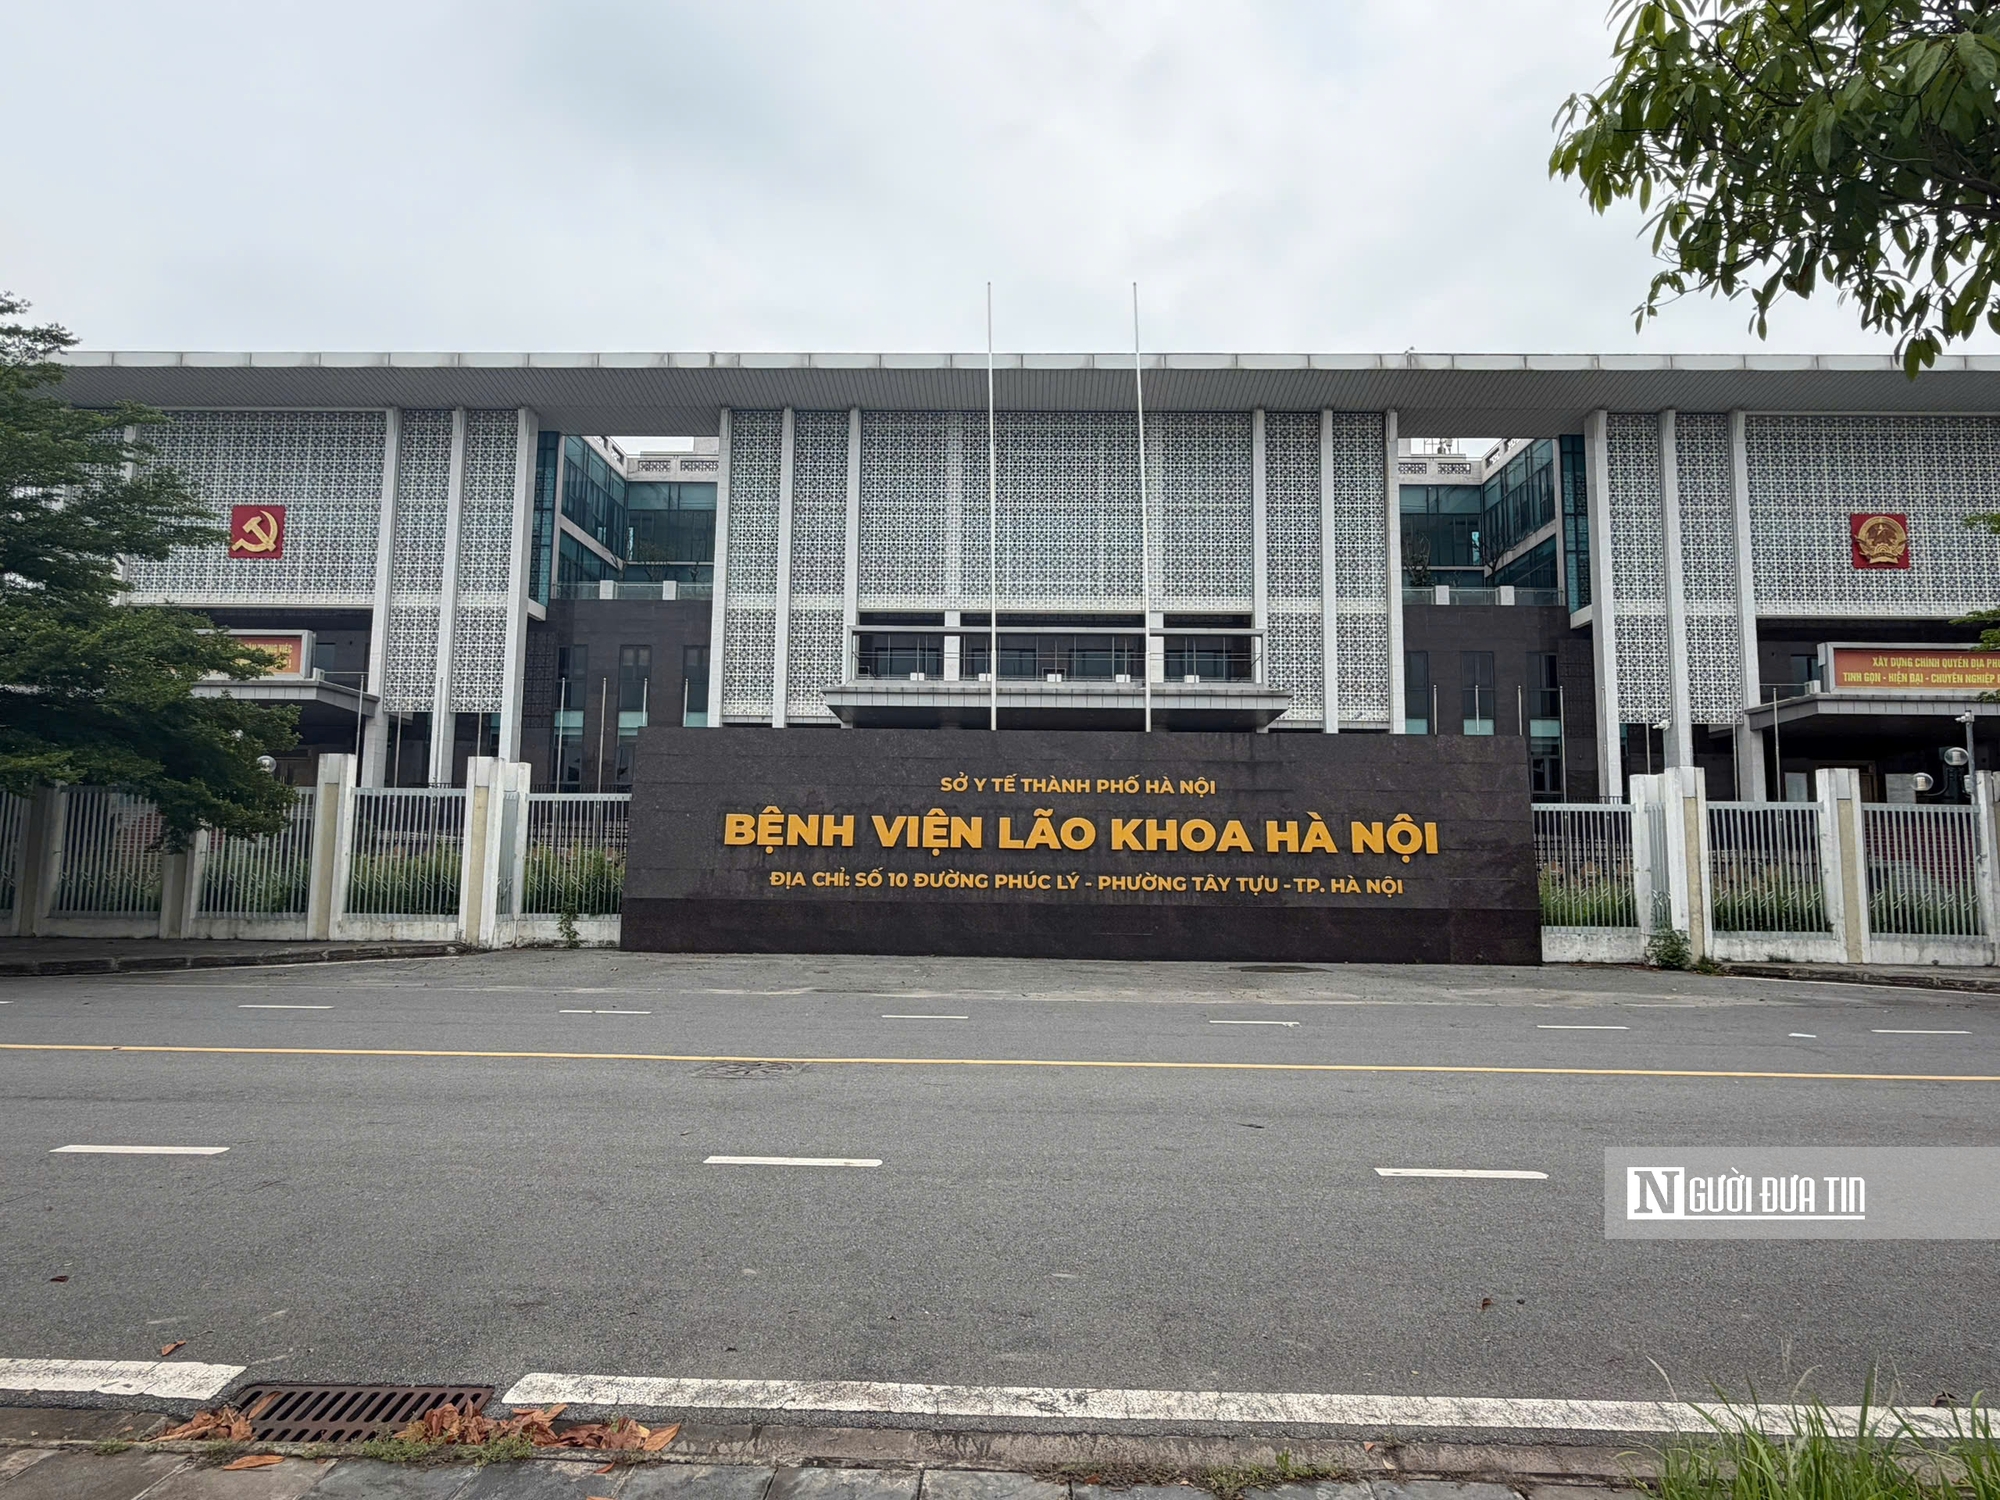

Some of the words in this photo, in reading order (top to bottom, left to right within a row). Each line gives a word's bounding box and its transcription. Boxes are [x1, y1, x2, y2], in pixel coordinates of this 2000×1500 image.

[1872, 655, 1888, 667] XÂY
[1890, 656, 1913, 669] DỰNG
[1915, 656, 1940, 668] CHÍNH
[1971, 658, 1985, 670] ĐỊA
[1843, 672, 1862, 682] TINH
[1864, 672, 1881, 684] GỌN
[1888, 671, 1908, 684] HIỆN
[1909, 673, 1924, 685] ĐẠI
[1931, 672, 1963, 683] CHUYÊN
[1965, 672, 1995, 685] NGHIỆP
[940, 771, 968, 792] SỞ
[974, 778, 987, 792] Y
[991, 773, 1017, 793] TẾ
[1020, 775, 1091, 793] THÀNH
[1096, 774, 1140, 794] PHỐ
[1145, 775, 1175, 794] HÀ
[1180, 777, 1216, 798] NỘI
[724, 805, 855, 854] BỆNH
[871, 807, 983, 857] VIỆN
[998, 808, 1097, 851] LÃO
[1111, 817, 1255, 852] KHOA
[1266, 811, 1339, 854] HÀ
[1350, 813, 1439, 864] NỘI
[769, 871, 806, 890] ĐỊA
[812, 867, 850, 888] CHỈ:
[855, 867, 883, 888] SỐ
[888, 872, 908, 888] 10
[913, 869, 989, 890] ĐƯỜNG
[994, 869, 1051, 890] PHÚC
[1057, 870, 1079, 890] LÝ
[1098, 872, 1187, 892] PHƯỜNG
[1192, 873, 1231, 892] TÂY
[1236, 875, 1279, 896] TỰU
[1331, 875, 1361, 894] HÀ
[1367, 876, 1404, 898] NỘI
